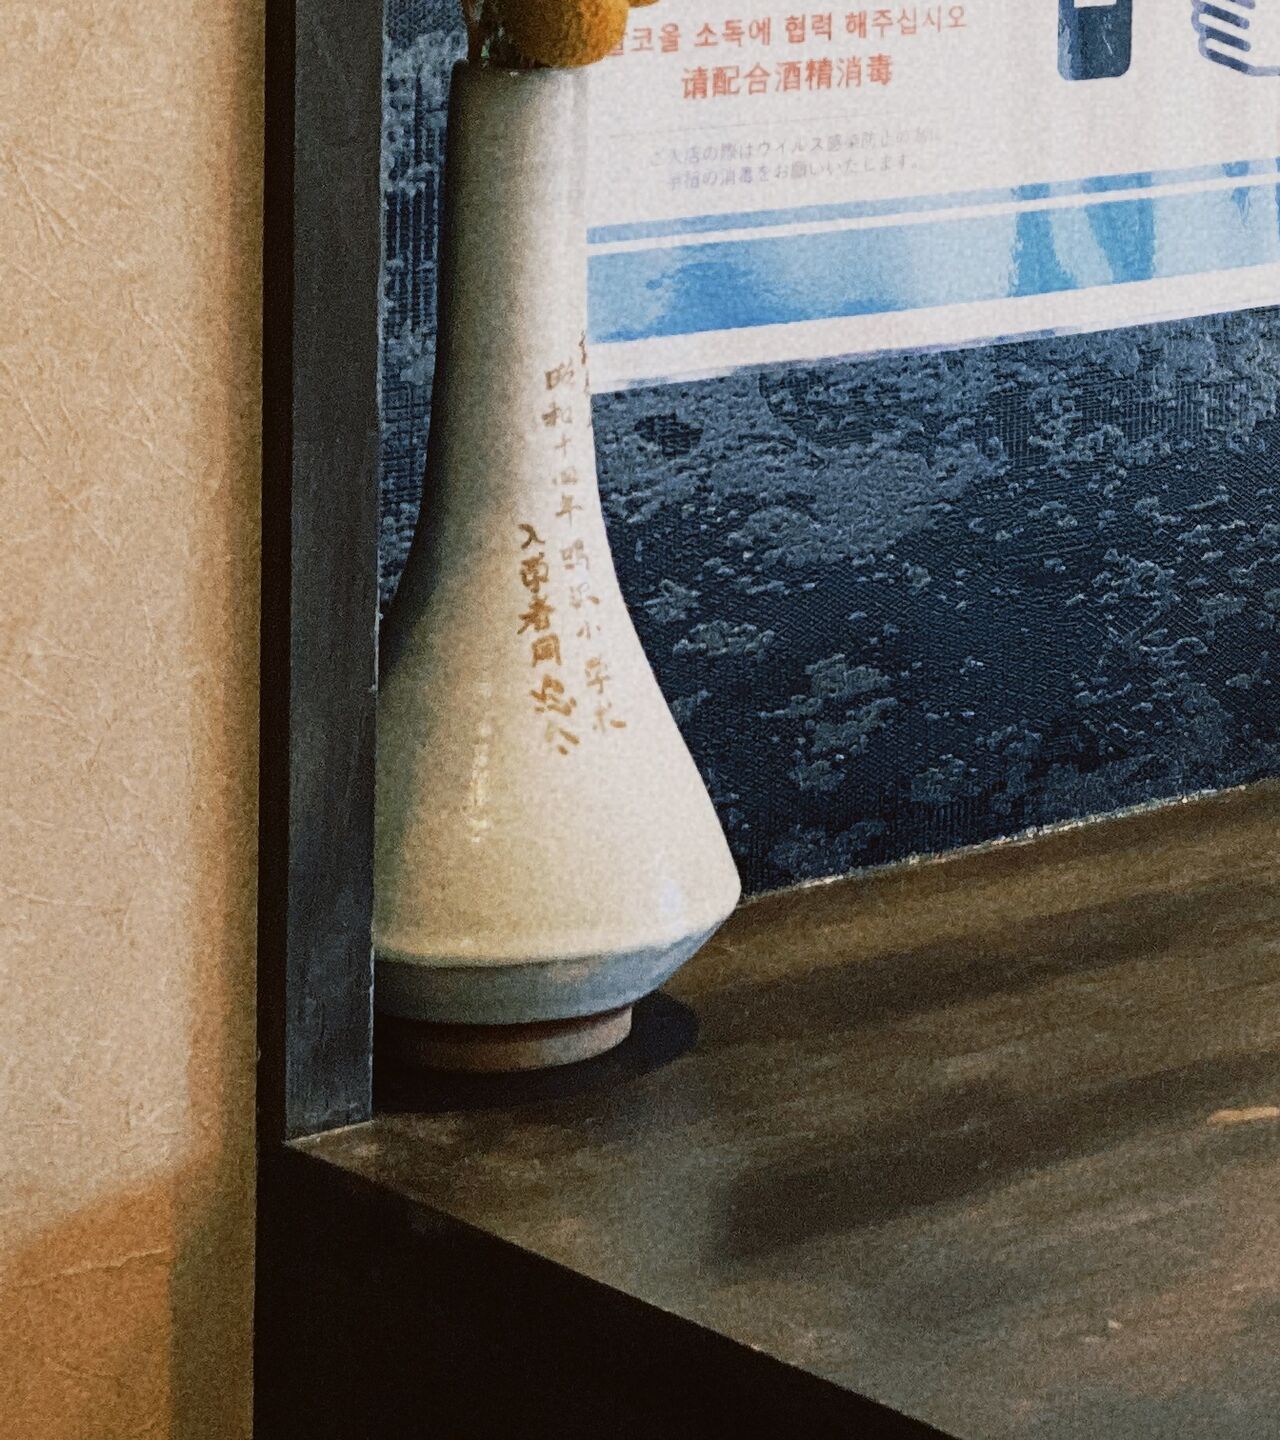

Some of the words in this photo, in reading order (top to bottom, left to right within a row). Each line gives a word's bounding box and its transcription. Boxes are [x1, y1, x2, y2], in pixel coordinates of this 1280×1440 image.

[693, 15, 773, 50] 소독에
[784, 12, 834, 45] 협력
[844, 4, 969, 41] 해주십시오
[681, 52, 894, 101] 请配合酒精消毒
